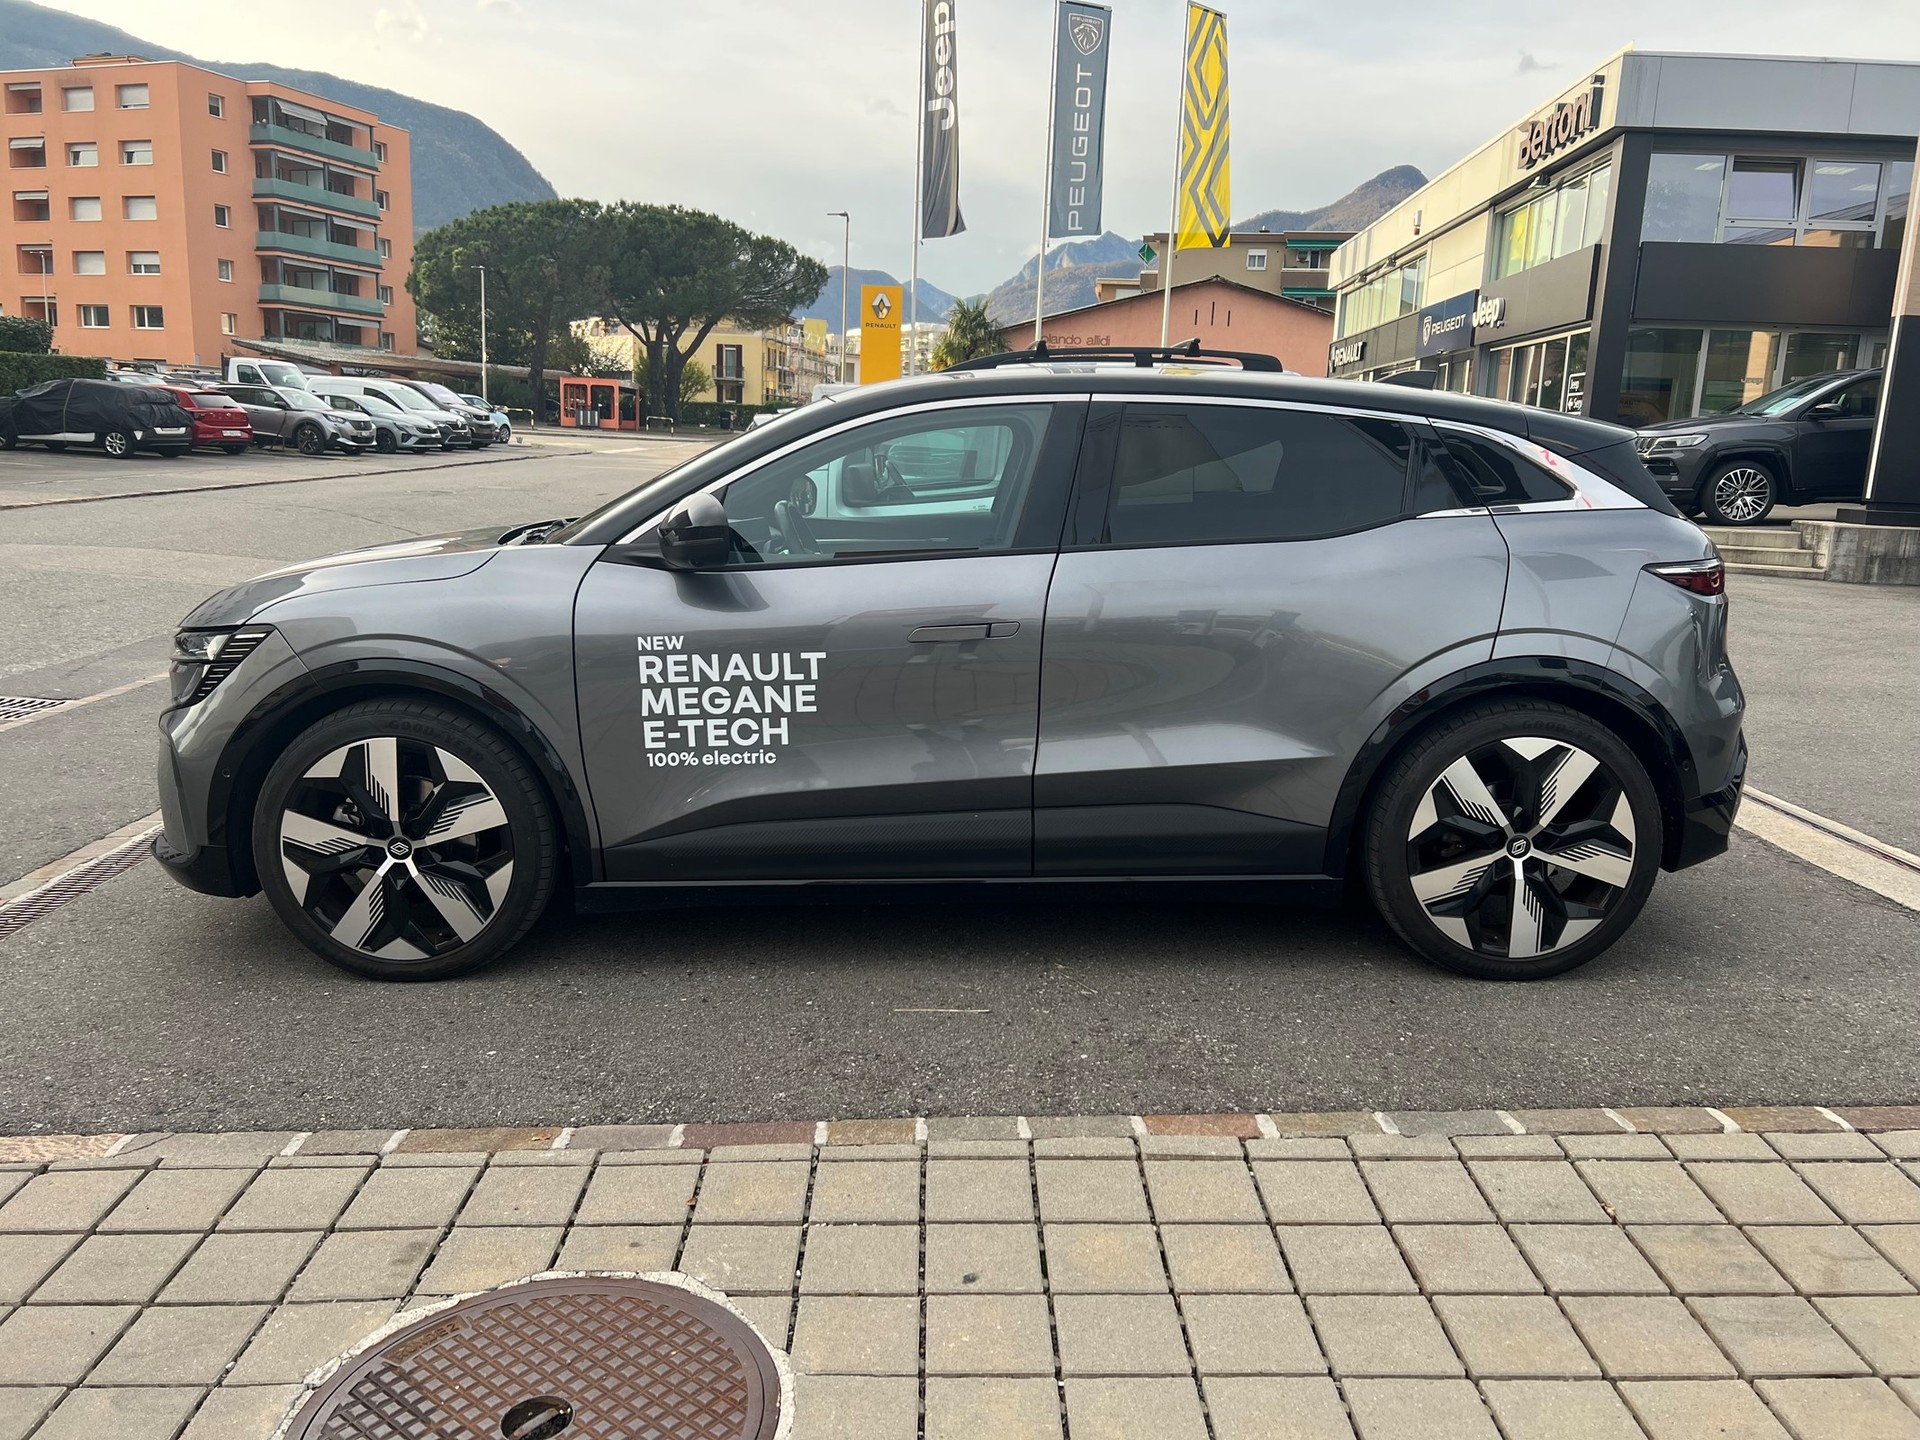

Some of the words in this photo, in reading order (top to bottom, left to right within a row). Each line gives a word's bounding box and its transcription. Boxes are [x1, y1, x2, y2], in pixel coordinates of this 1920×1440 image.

[928, 2, 956, 130] Jeep
[1517, 75, 1605, 169] Bertoni
[1068, 63, 1093, 231] PEUGEOT
[1431, 313, 1467, 336] PEUGEOT
[1472, 295, 1503, 329] Jeep
[1334, 341, 1364, 368] RENAULT
[637, 635, 685, 651] NEW
[638, 651, 827, 684] RENAULT
[641, 684, 818, 717] MEGANE
[643, 717, 790, 749] E-TECH
[646, 751, 700, 768] 100%
[702, 749, 777, 766] electric
